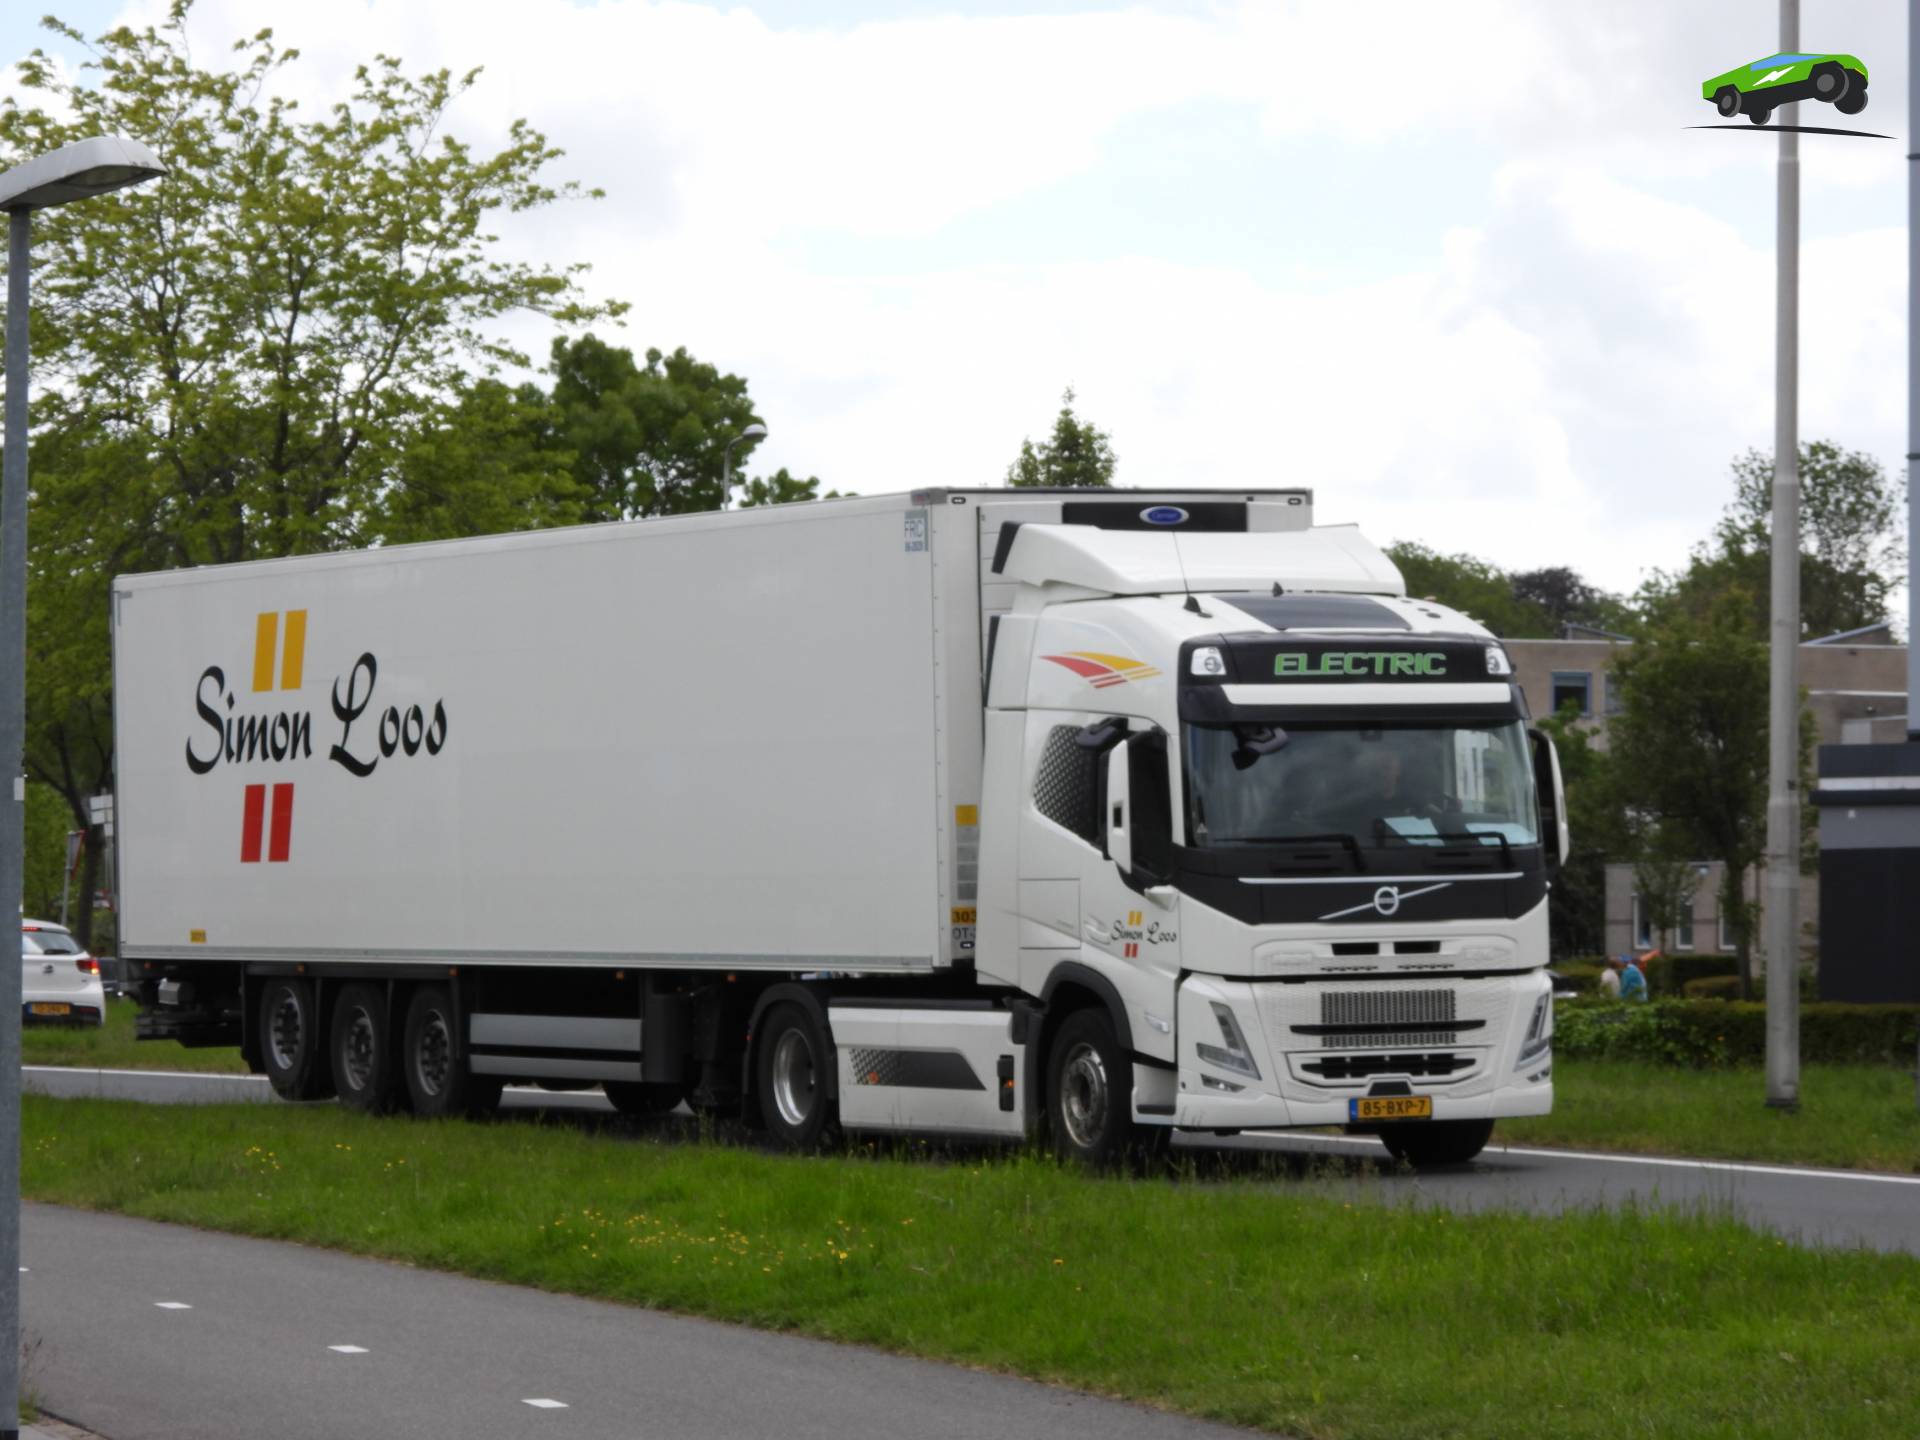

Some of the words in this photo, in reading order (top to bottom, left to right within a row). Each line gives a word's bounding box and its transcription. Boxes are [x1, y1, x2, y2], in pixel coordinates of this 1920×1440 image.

[1274, 653, 1447, 676] ELECTRIC
[186, 666, 312, 775] Simon
[329, 652, 447, 777] Loos
[1111, 920, 1143, 940] Simon
[1147, 921, 1177, 944] Loos
[1363, 1101, 1425, 1115] 85-BXP-7
